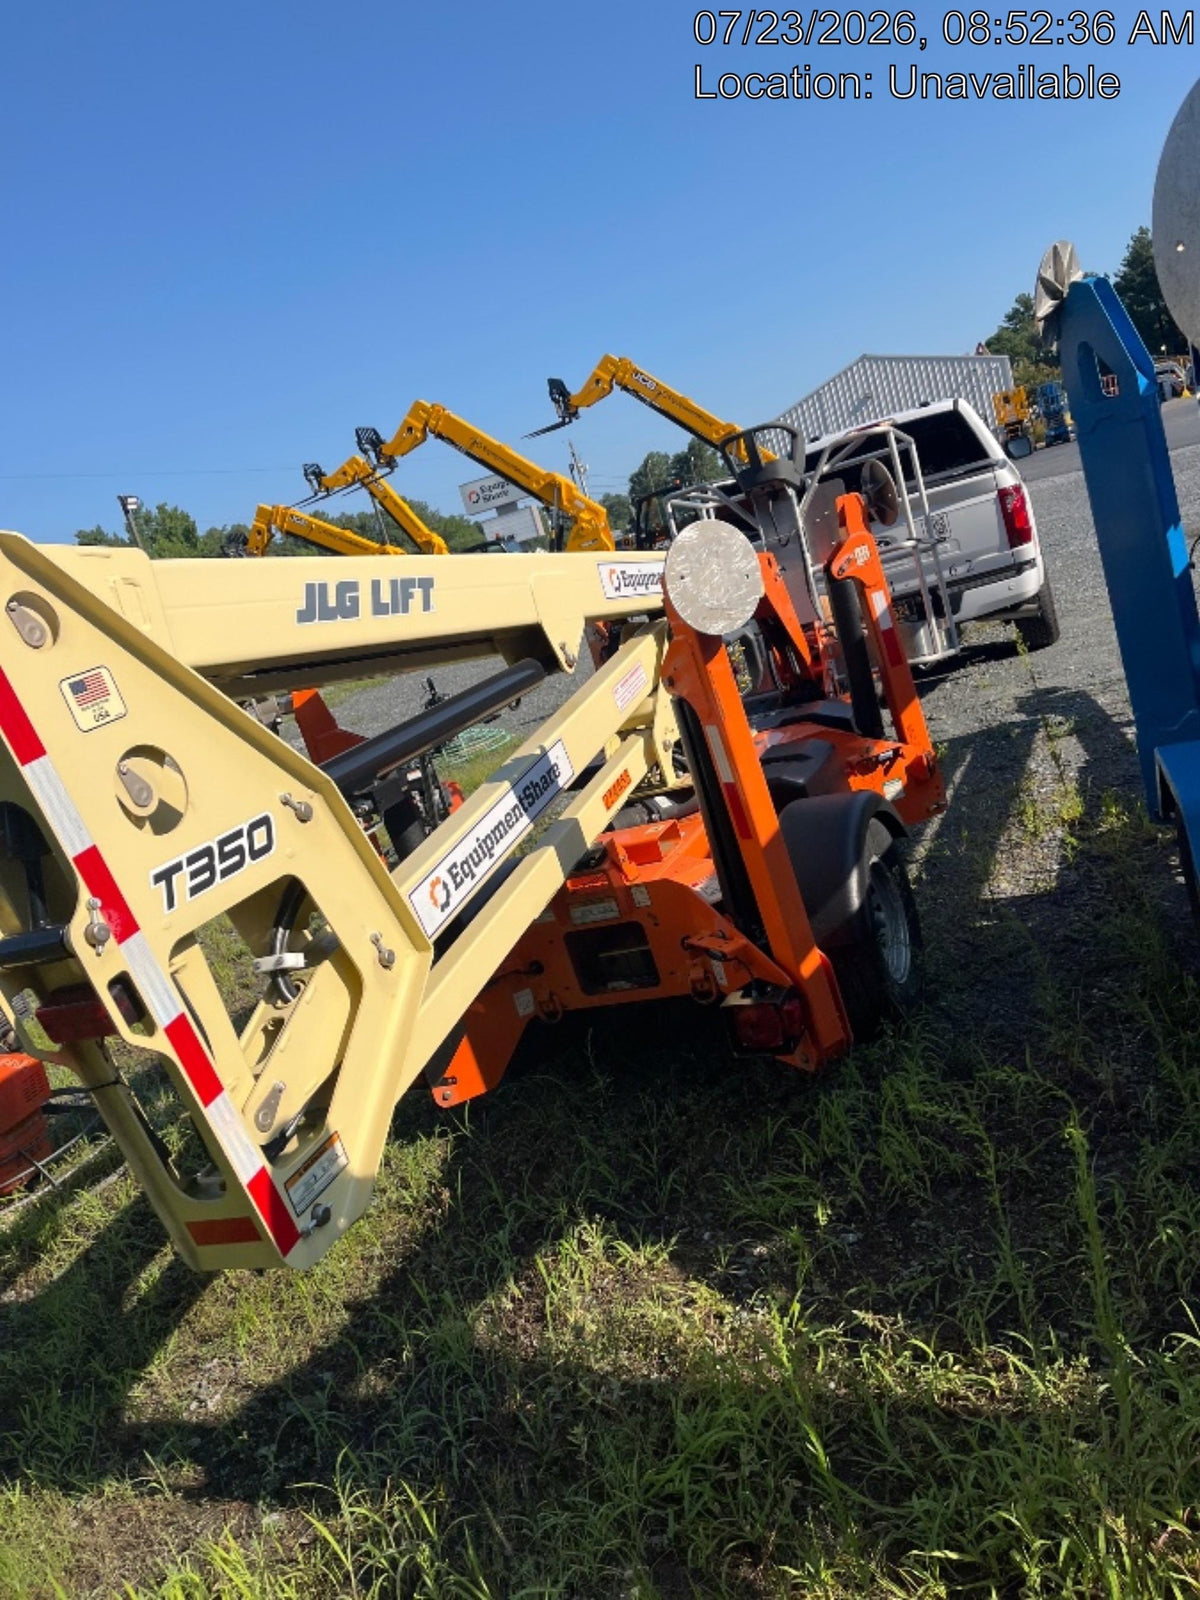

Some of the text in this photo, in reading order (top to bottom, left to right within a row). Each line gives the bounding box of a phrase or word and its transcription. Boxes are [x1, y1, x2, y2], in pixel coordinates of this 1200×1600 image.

[296, 577, 434, 623] JLG LIFT
[152, 813, 275, 912] T350
[446, 762, 562, 891] EquipmentShare
